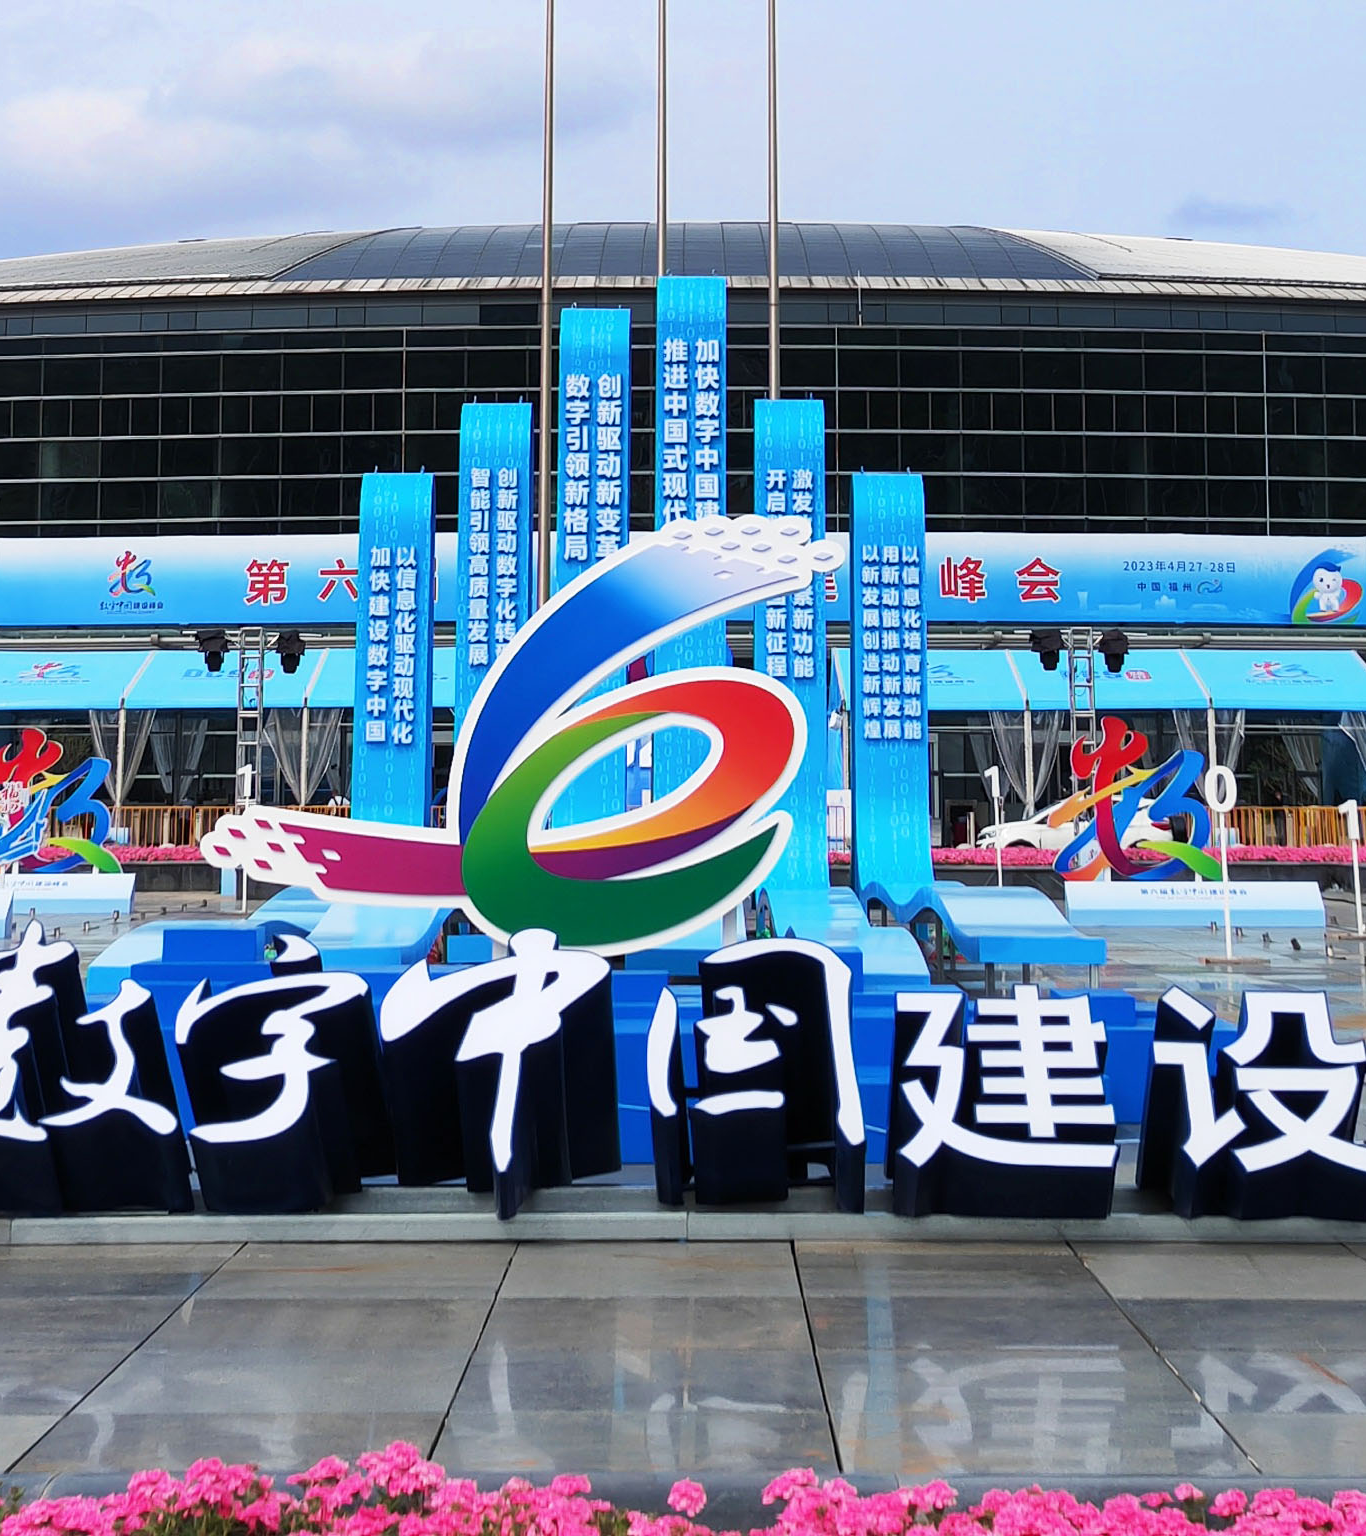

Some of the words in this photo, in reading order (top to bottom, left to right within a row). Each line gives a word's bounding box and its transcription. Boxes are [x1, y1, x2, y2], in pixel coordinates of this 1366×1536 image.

[563, 373, 591, 561] 数字引领新格局
[595, 373, 622, 558] 创新驱动新变革
[365, 547, 391, 742] 加快建设数字中国
[392, 546, 418, 745] 以信息化驱动现代化
[467, 467, 492, 667] 智能引领高质量发展
[494, 467, 519, 658] 创新驱动数字化转
[860, 544, 881, 740] 以新发展创造新辉煌
[881, 546, 901, 739] 用新动能推动新发展
[901, 546, 922, 740] 以信息化培育新动能
[1123, 560, 1236, 573] 2023年4月27-28日
